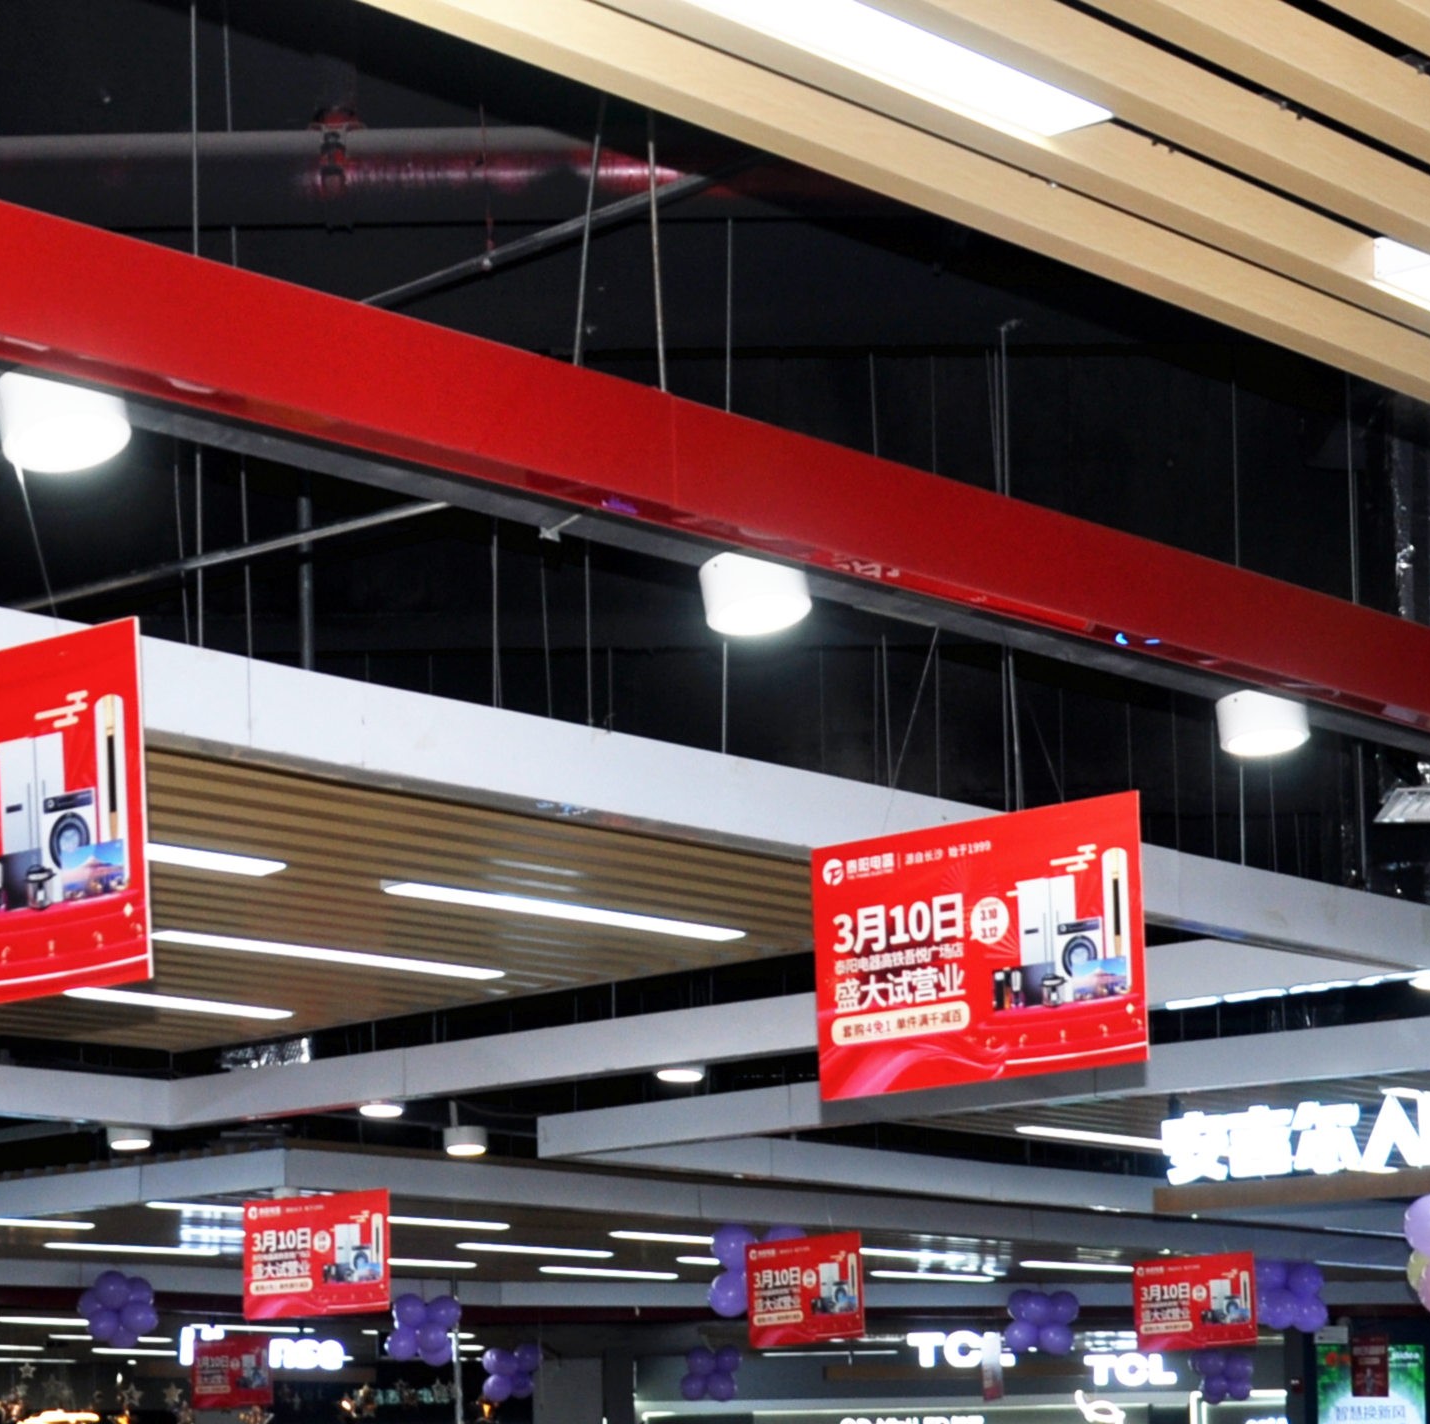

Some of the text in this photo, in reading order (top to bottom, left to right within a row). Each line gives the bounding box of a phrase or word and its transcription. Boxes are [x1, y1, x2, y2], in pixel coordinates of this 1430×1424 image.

[832, 892, 964, 955] 3月10日
[835, 963, 966, 1014] 盛大试营业
[251, 1227, 312, 1253] 3月10日
[753, 1266, 801, 1289] 3月10日
[1140, 1281, 1190, 1302] 3月10日
[1083, 1353, 1178, 1387] TCL
